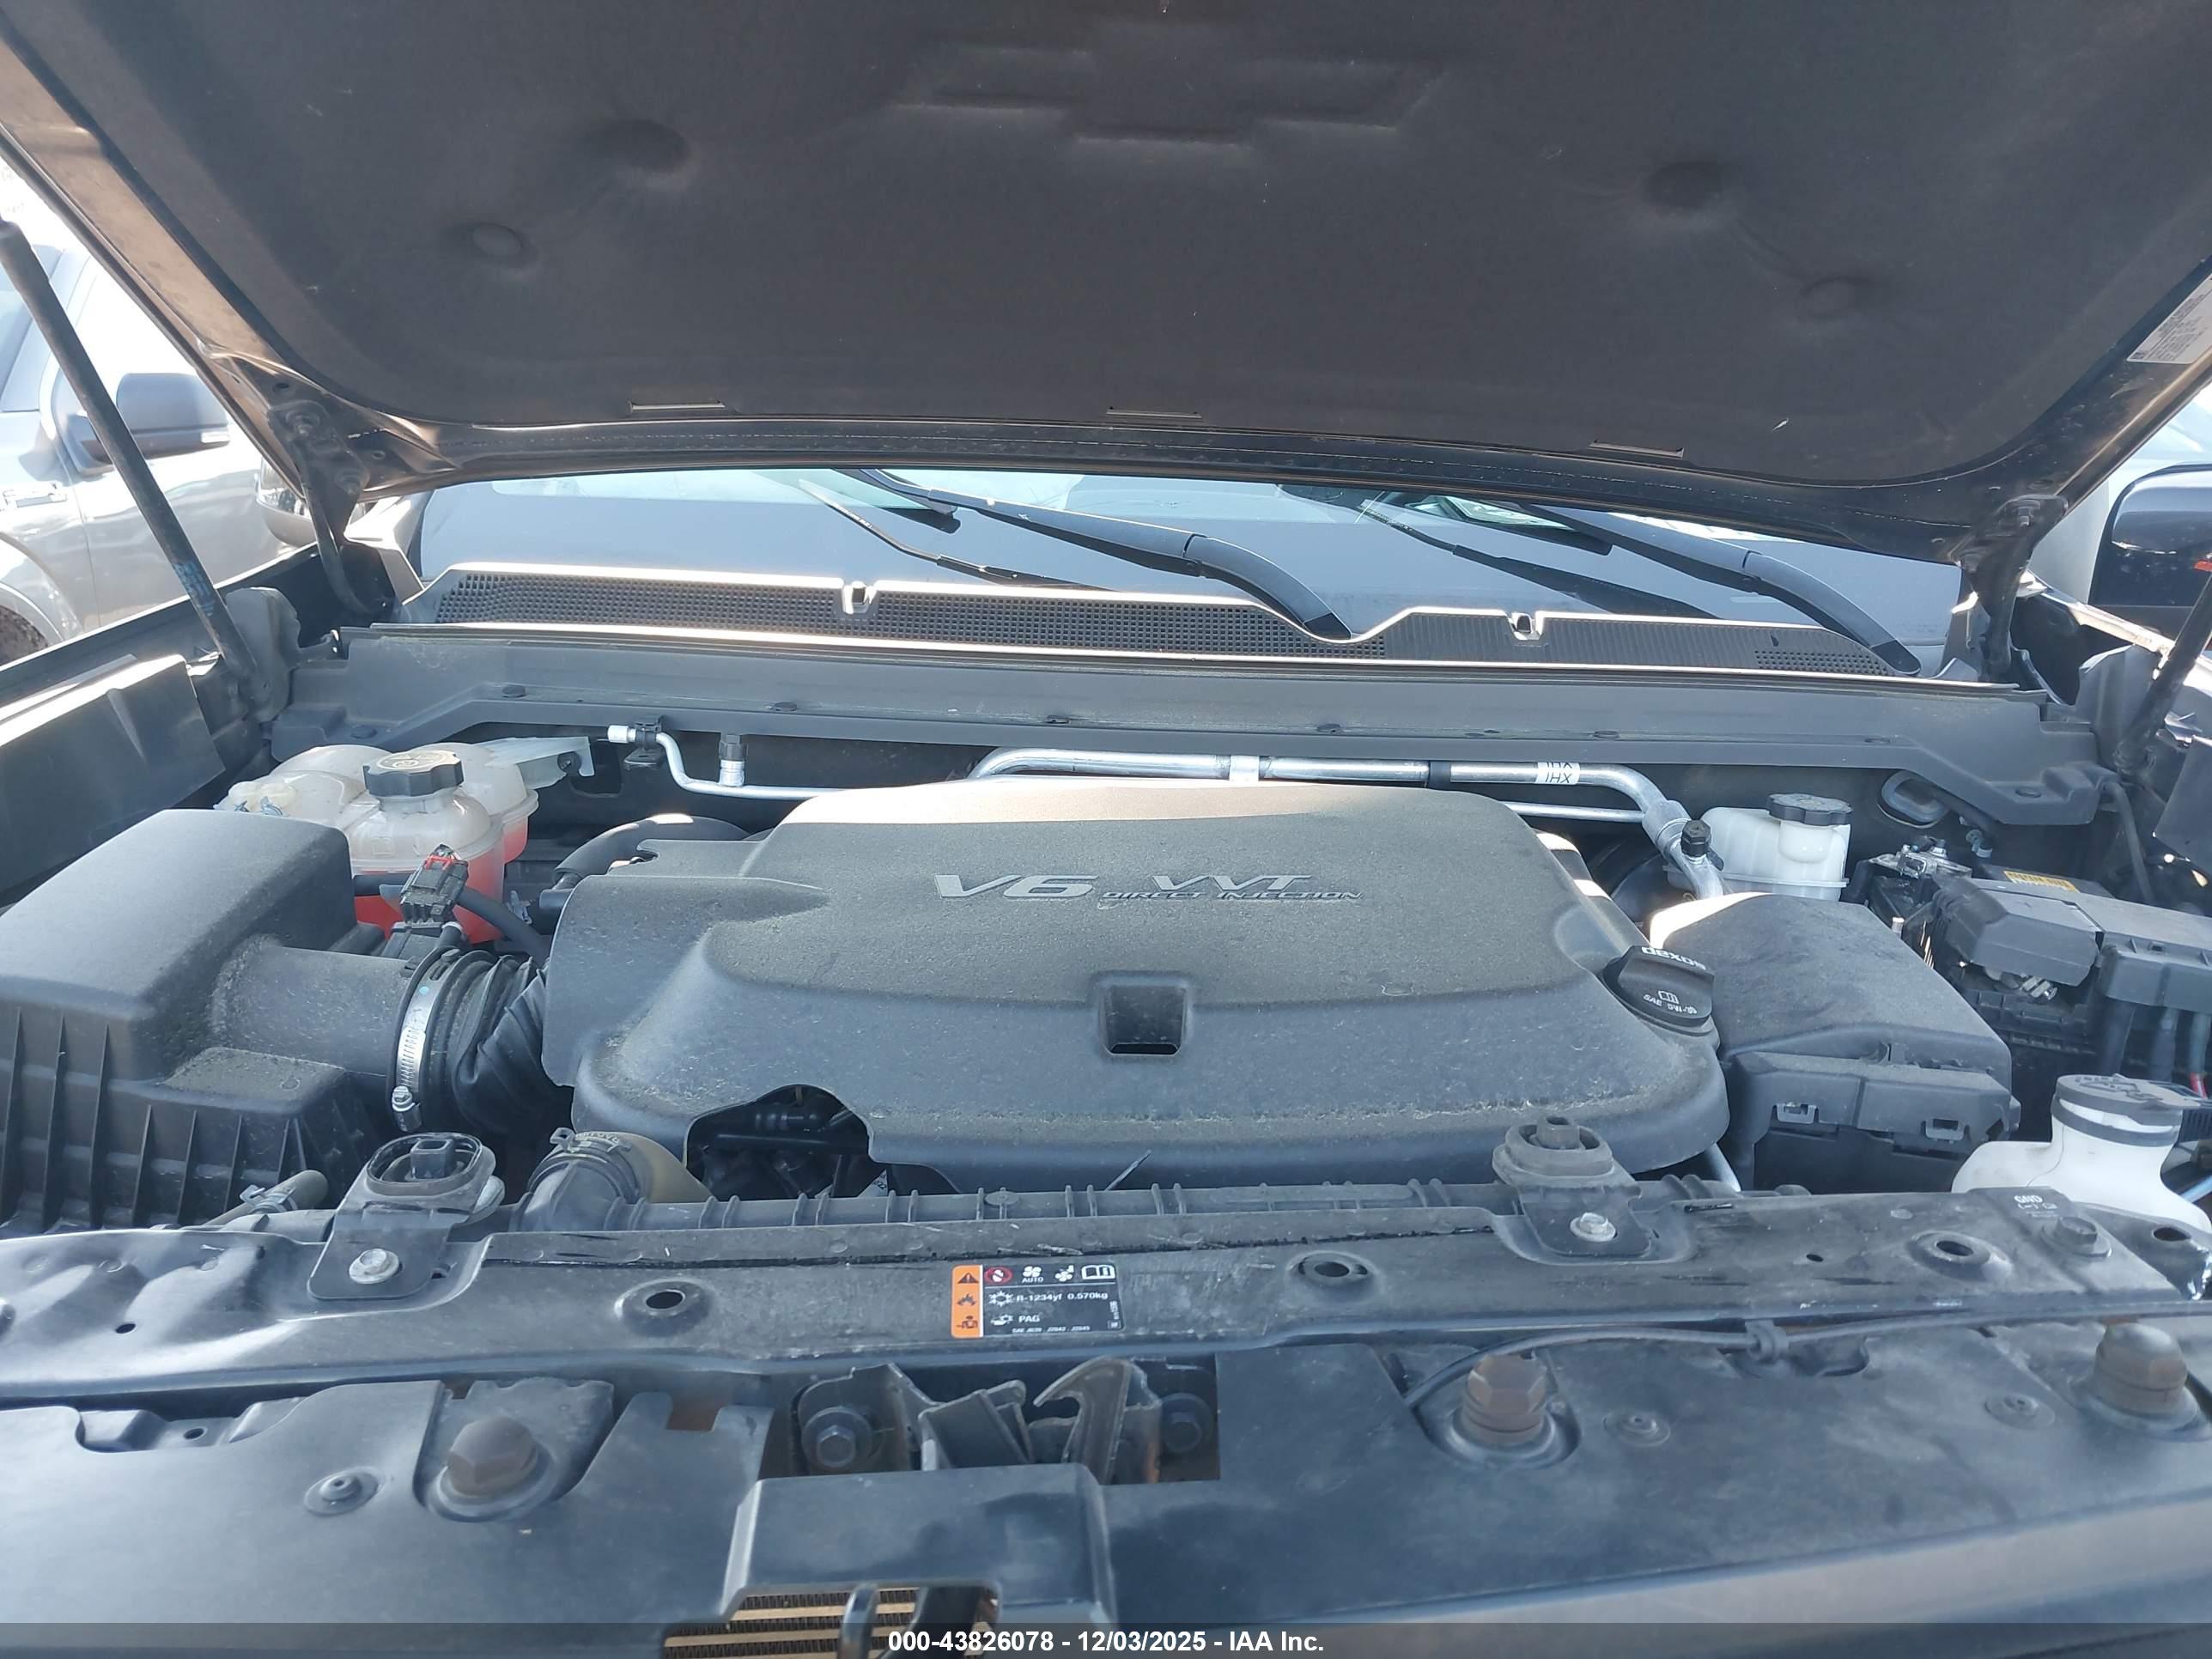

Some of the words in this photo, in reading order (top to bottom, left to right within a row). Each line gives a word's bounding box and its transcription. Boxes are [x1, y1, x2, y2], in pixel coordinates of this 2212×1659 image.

[934, 875, 1098, 899] V6
[1152, 874, 1312, 891] VVT
[1103, 891, 1206, 900] DIRECT
[1217, 891, 1364, 900] INJECTION
[1018, 1315, 1041, 1323] PAG
